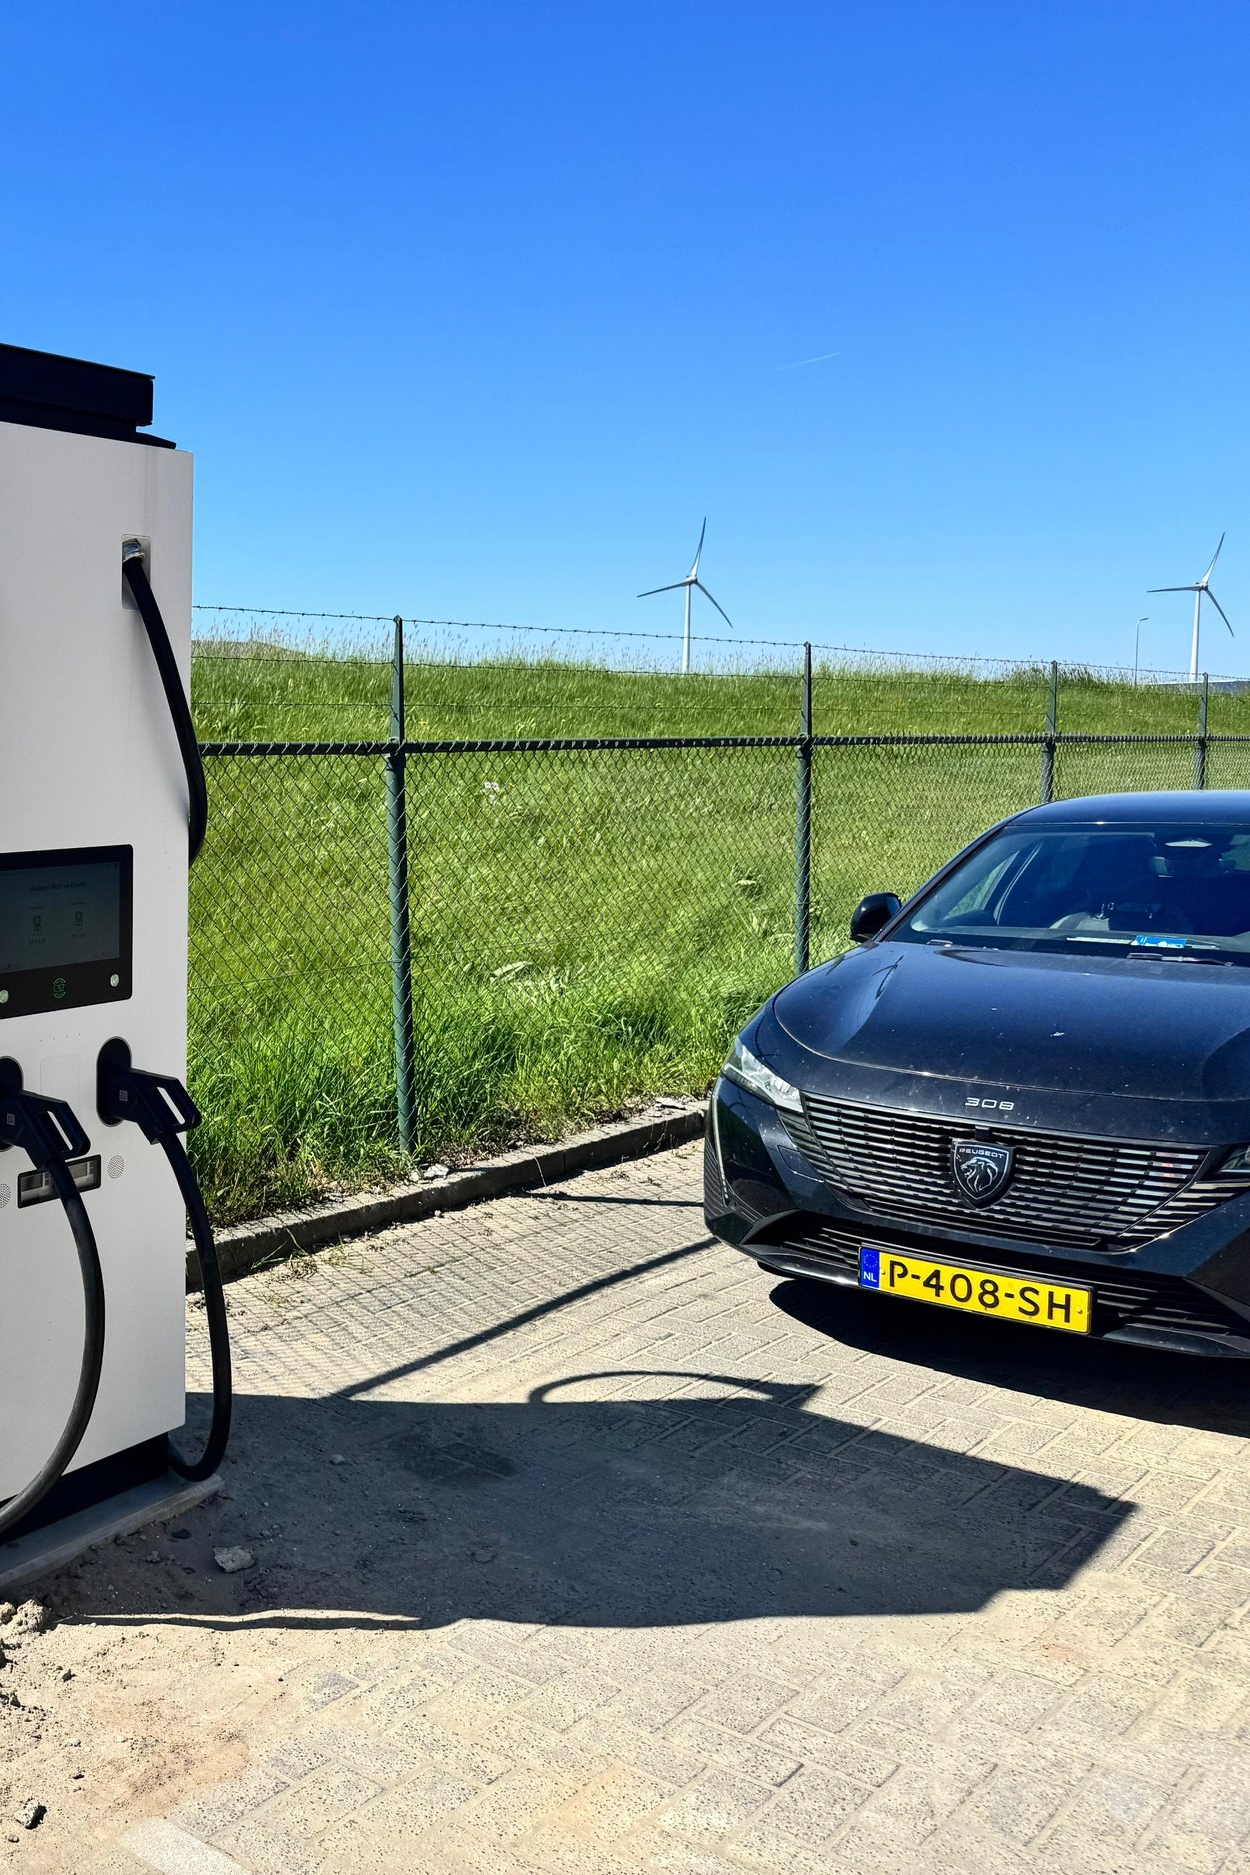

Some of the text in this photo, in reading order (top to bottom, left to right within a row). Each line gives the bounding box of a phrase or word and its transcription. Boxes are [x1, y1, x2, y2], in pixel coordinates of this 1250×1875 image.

[965, 1097, 1014, 1110] 308
[959, 1148, 1004, 1158] PEUGEOT
[863, 1271, 877, 1282] NL
[889, 1260, 1071, 1323] P-408-SH
